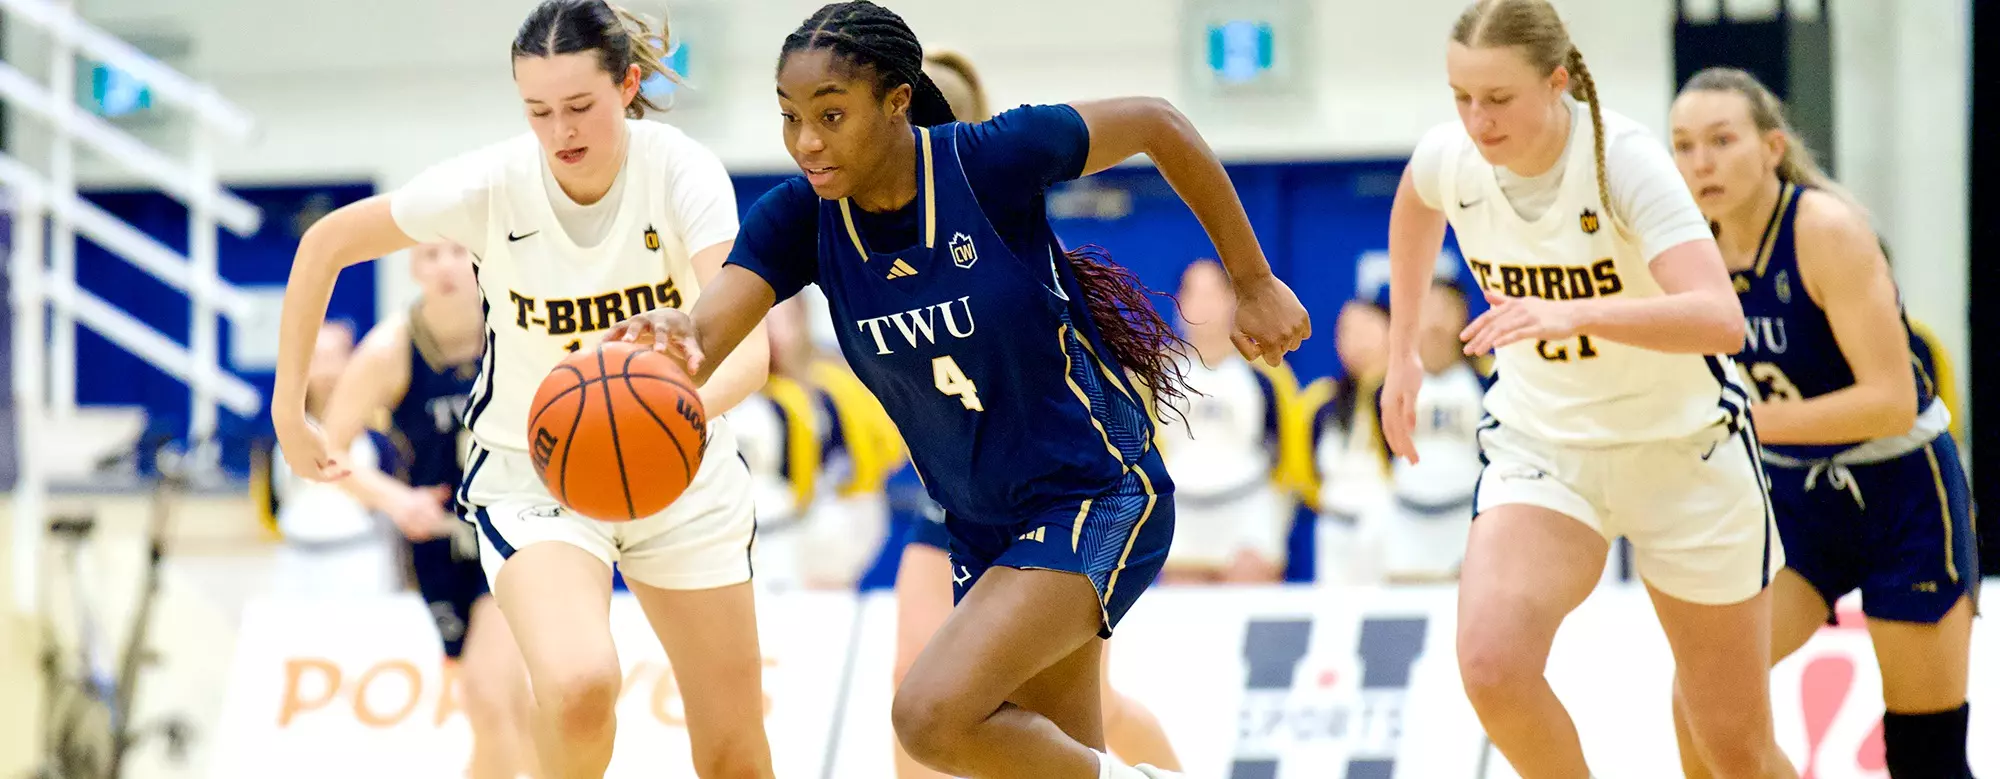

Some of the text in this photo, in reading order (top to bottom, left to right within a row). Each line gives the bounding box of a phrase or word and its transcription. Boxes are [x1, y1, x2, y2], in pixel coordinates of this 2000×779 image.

[953, 243, 974, 263] CW
[1470, 257, 1623, 301] T-BIRDS
[508, 274, 682, 335] T-BIRDS
[856, 296, 975, 355] TWU
[1742, 316, 1788, 353] WU
[931, 355, 984, 412] 4
